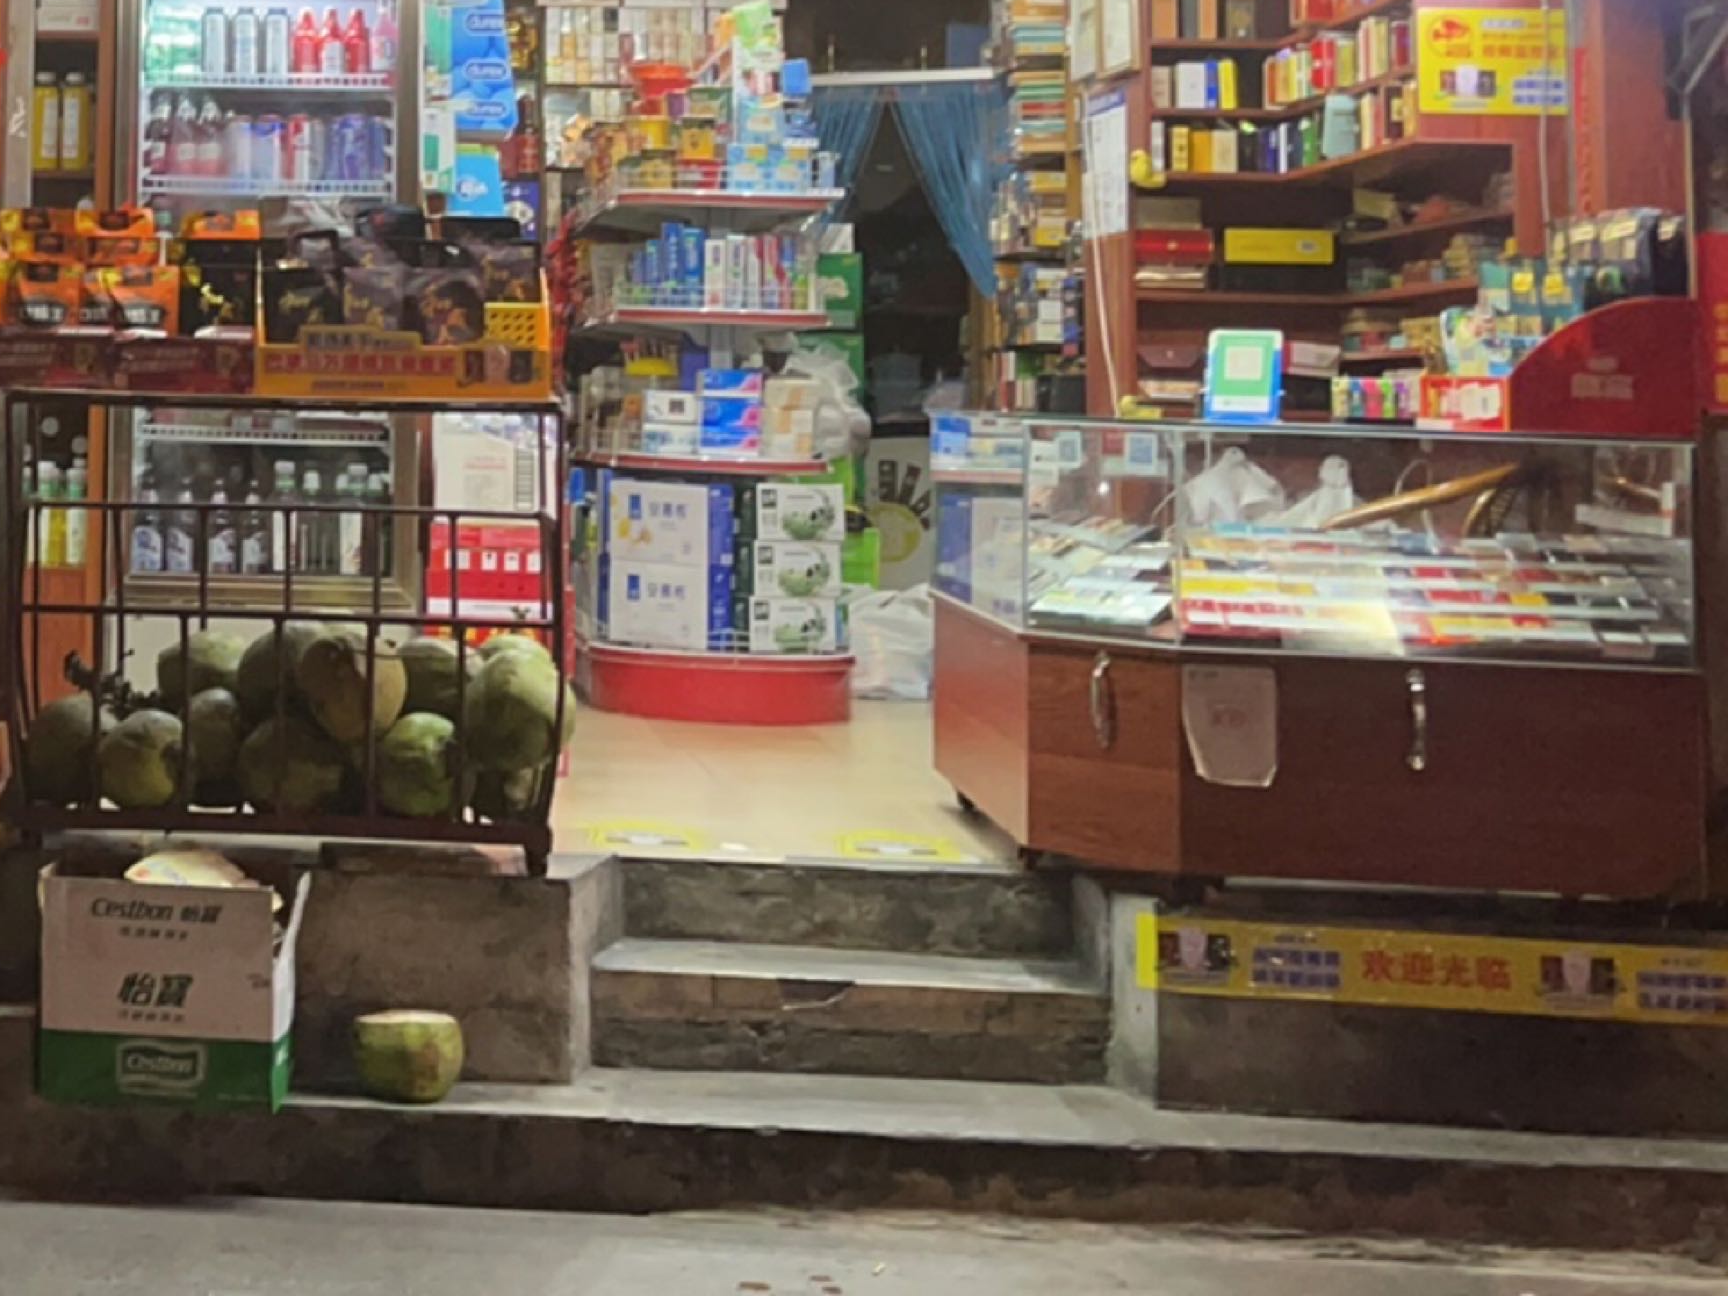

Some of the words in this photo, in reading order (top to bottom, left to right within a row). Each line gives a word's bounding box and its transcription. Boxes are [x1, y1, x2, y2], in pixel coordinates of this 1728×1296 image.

[90, 898, 173, 920] Cestbon
[1360, 948, 1512, 991] 欢迎光临
